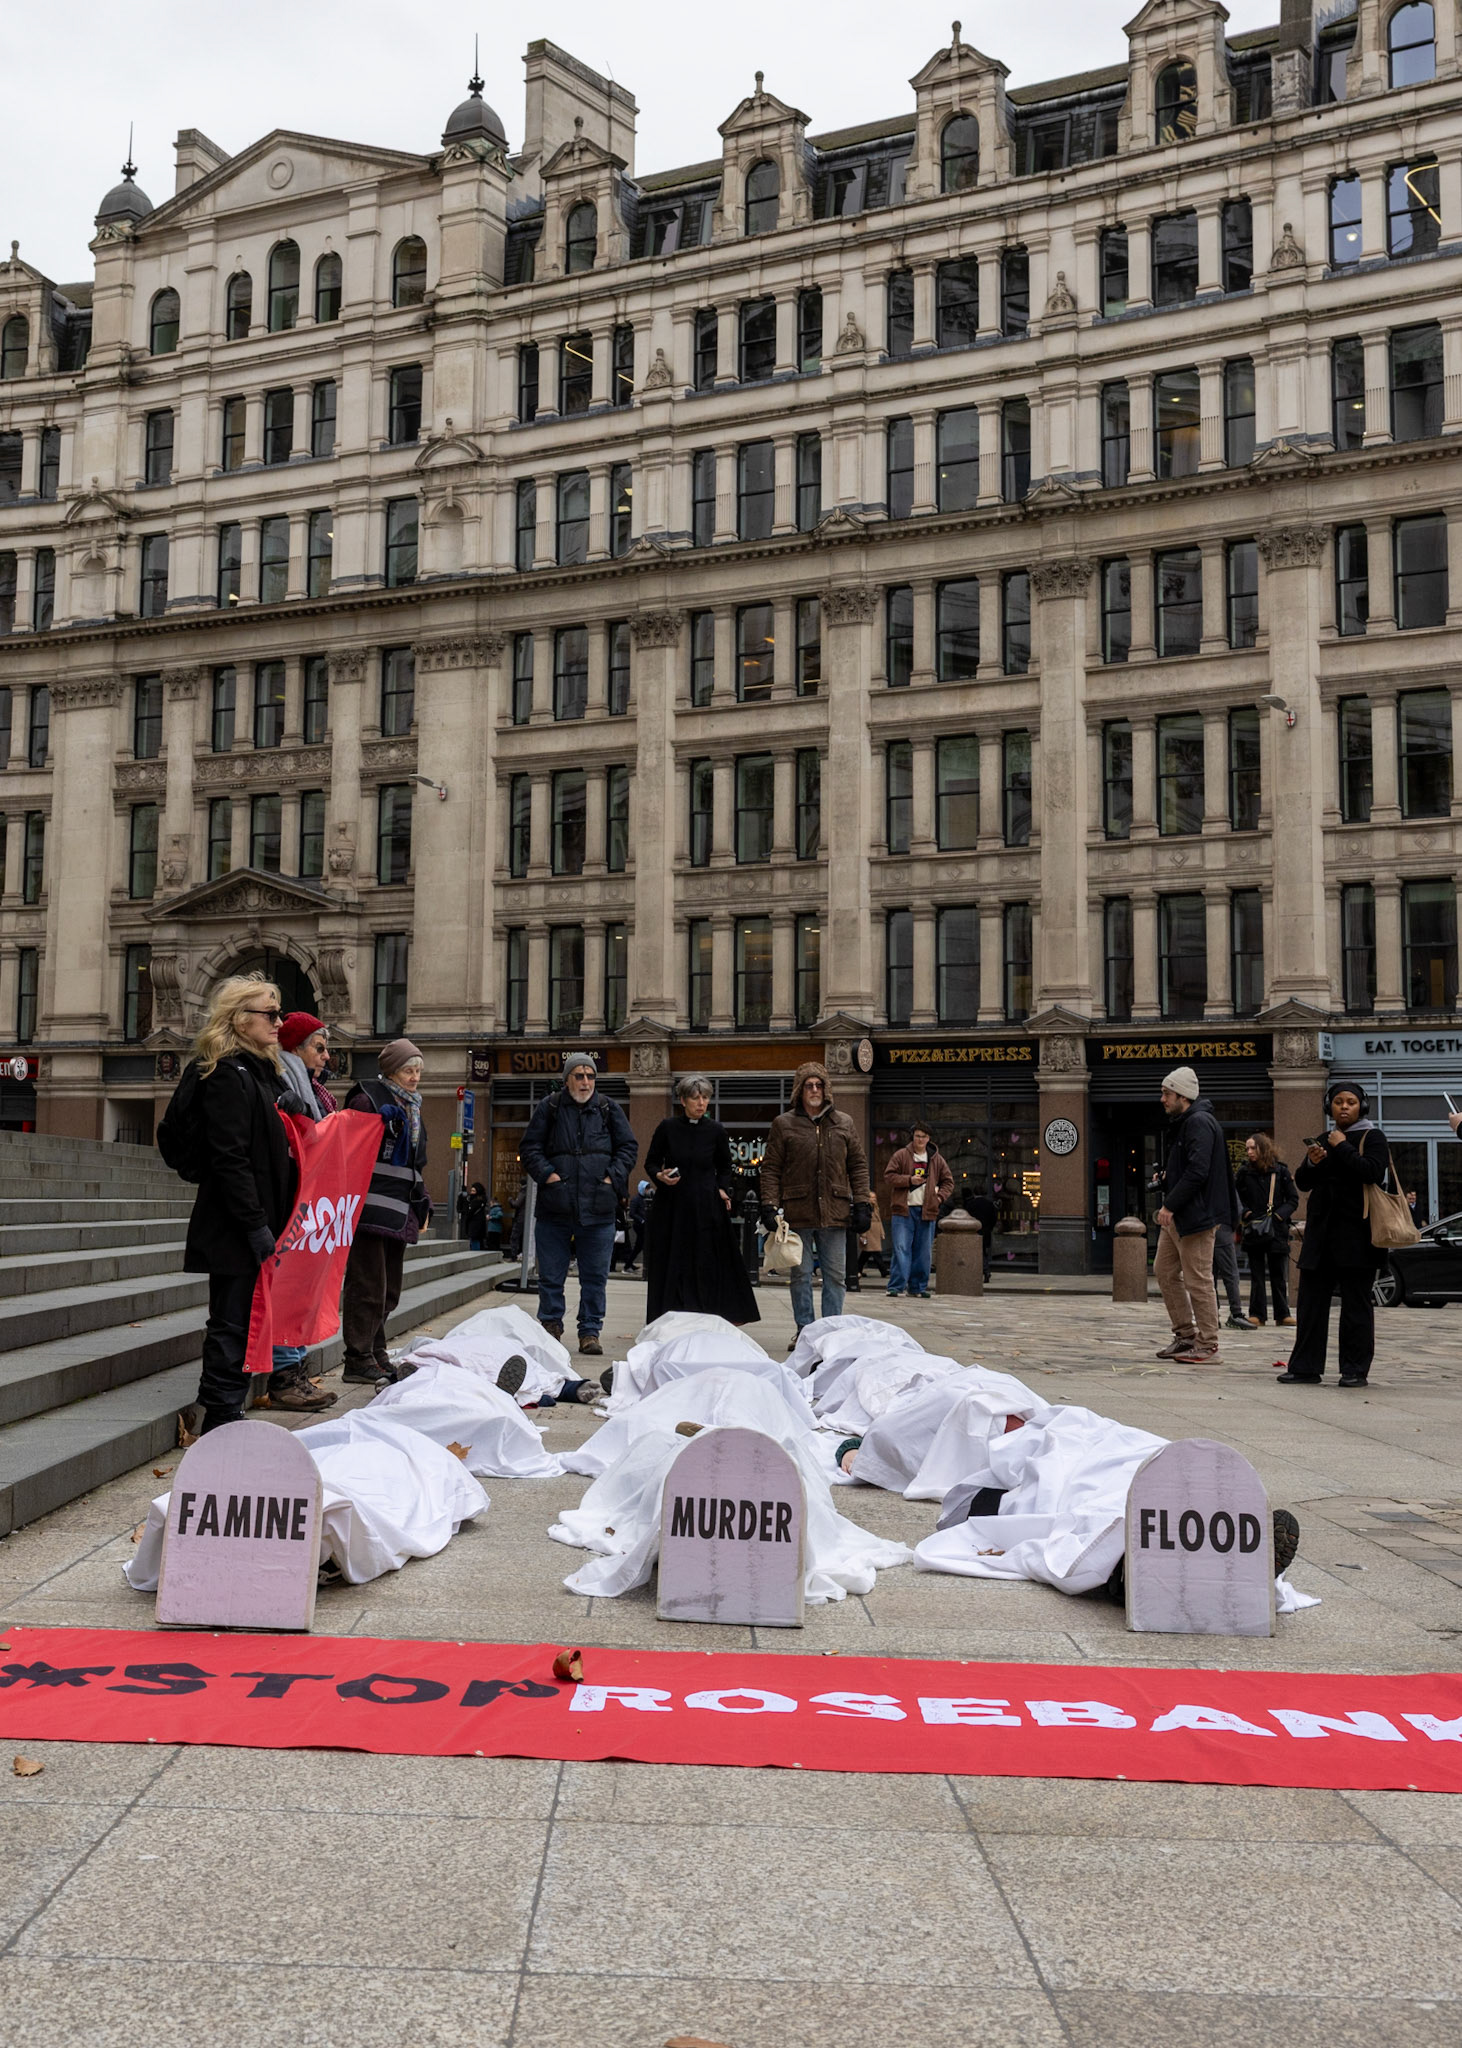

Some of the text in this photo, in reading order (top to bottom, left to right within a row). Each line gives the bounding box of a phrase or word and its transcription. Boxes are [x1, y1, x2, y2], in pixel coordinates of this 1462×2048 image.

[513, 1052, 560, 1072] SOHO
[1365, 1040, 1396, 1054] EAT.
[474, 1060, 489, 1070] SOHO
[178, 1492, 308, 1541] FAMINE
[671, 1496, 793, 1543] MURDER
[1140, 1508, 1261, 1553] FLOOD
